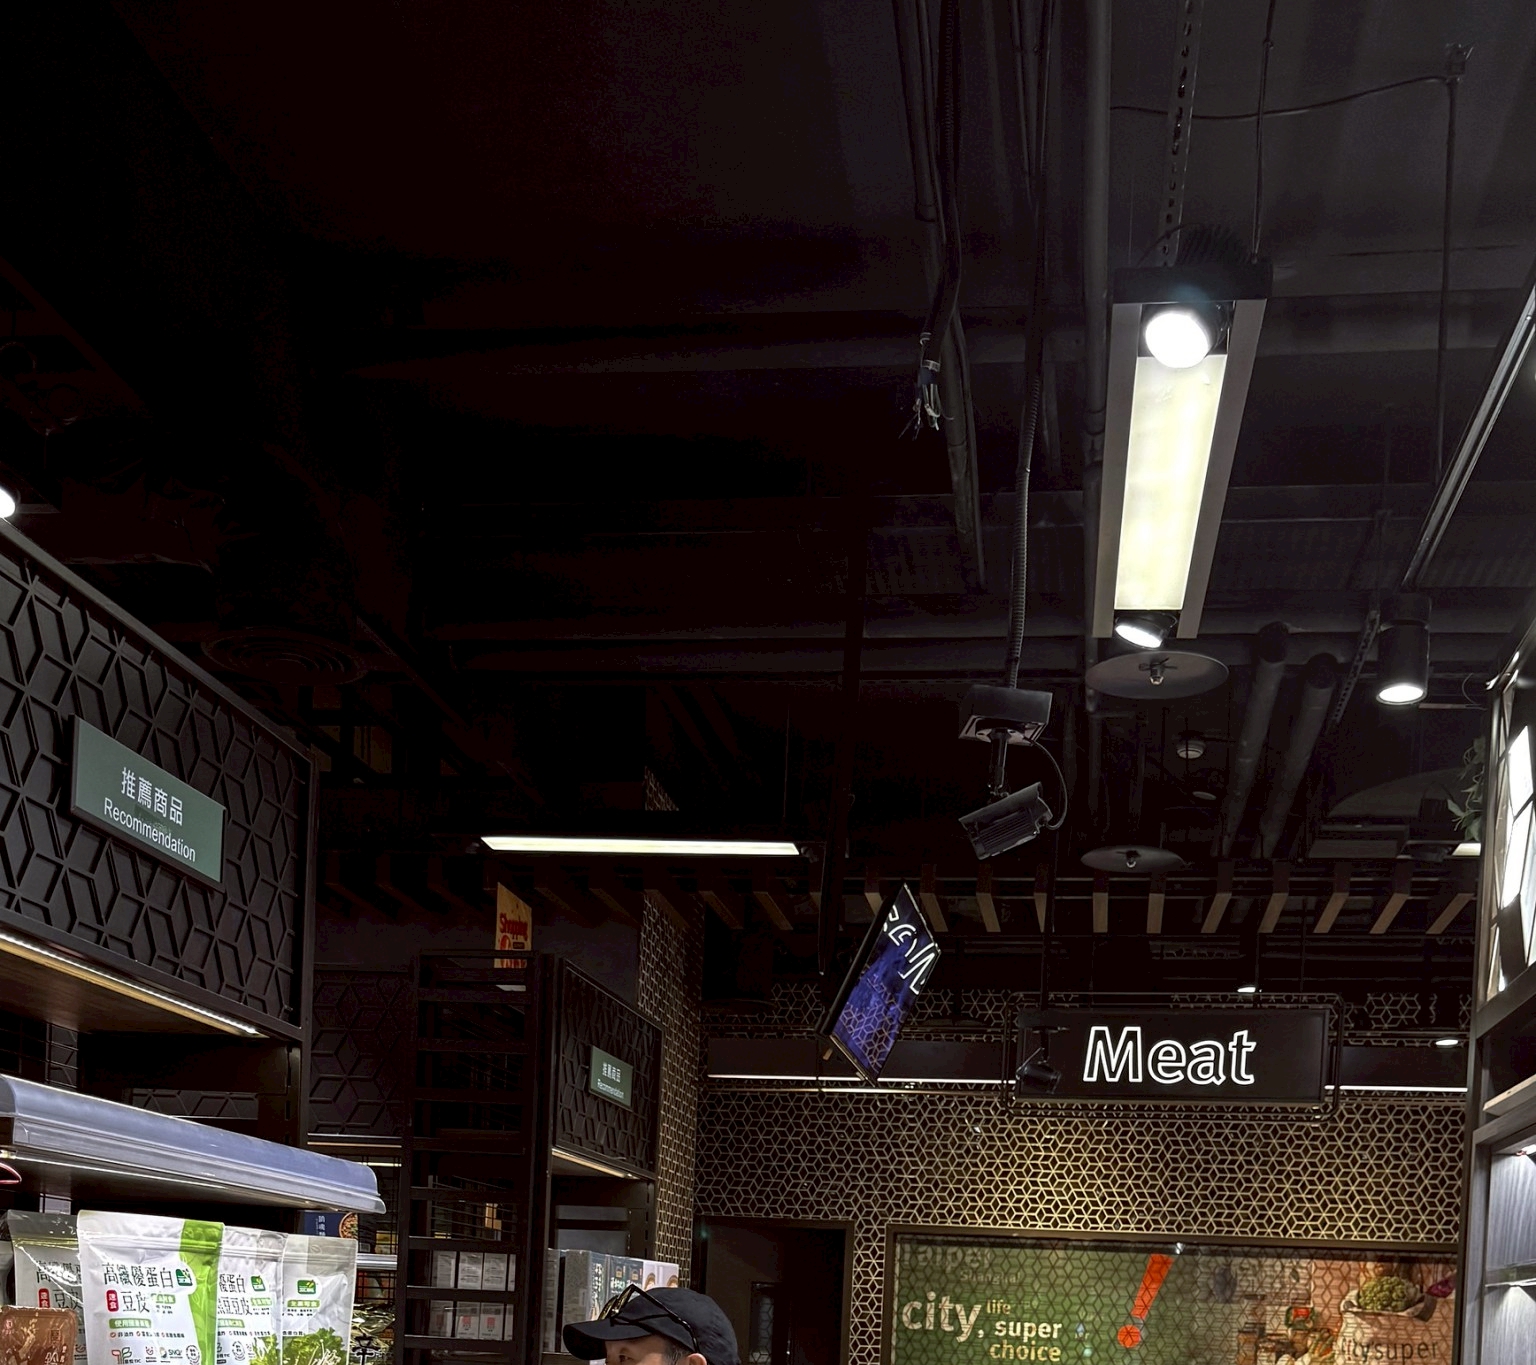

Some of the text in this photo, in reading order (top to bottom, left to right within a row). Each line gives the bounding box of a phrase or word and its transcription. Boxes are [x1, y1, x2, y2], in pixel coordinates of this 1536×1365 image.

[121, 766, 184, 827] 推薦商品
[103, 797, 196, 862] Recommendation
[1083, 1025, 1257, 1085] Meat
[986, 1299, 1012, 1315] life
[989, 1340, 1062, 1362] choice
[994, 1320, 1063, 1342] super
